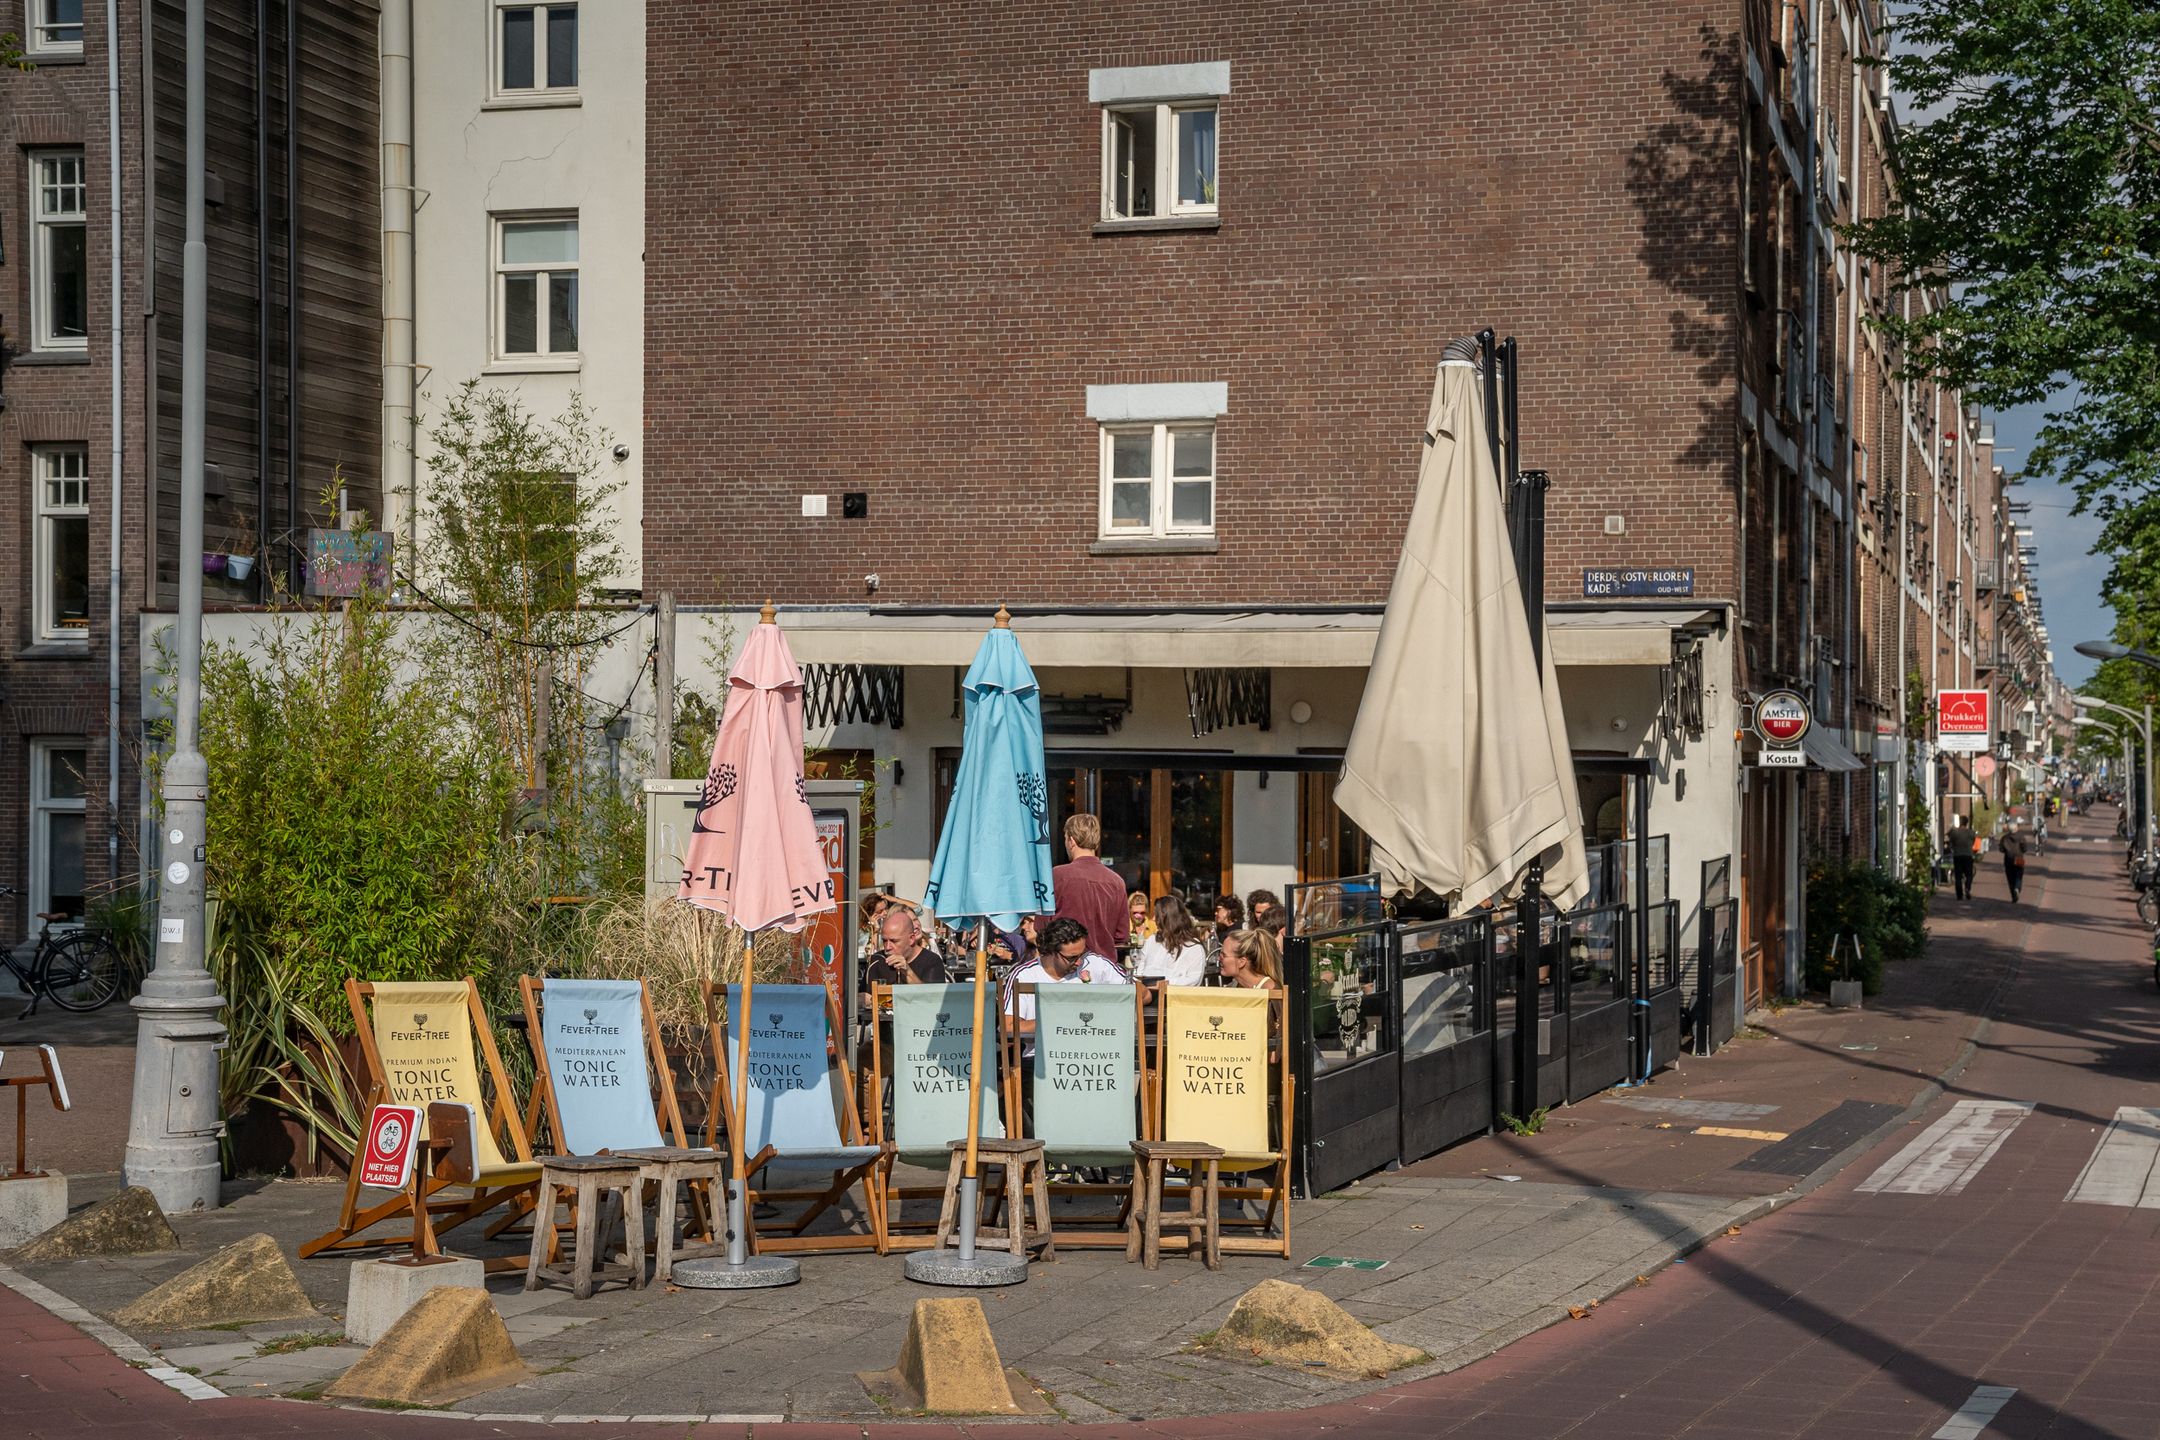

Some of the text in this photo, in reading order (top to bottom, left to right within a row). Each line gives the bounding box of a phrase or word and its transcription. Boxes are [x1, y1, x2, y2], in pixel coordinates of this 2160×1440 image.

[1587, 571, 1690, 582] DERDE KOSTVERLOREN
[1587, 583, 1611, 594] KADE
[1765, 709, 1801, 718] AMSTEL
[1942, 713, 1984, 722] Drukkerij
[1942, 722, 1984, 730] Overtoom
[1766, 754, 1798, 764] Kosta
[560, 1024, 619, 1035] FEVER-TREE
[913, 1027, 973, 1037] FEVER-TREE
[1056, 1026, 1117, 1036] FEVER-TREE
[391, 1031, 450, 1041] FEVER-TREE
[1185, 1030, 1246, 1041] FEVER-TREE
[555, 1047, 626, 1056] MEDITERRANEAN
[748, 1051, 811, 1059] EDITERRANEAN
[907, 1051, 972, 1061] ELDERFLOWE
[1049, 1050, 1121, 1060] ELDERFLOWER
[427, 1056, 458, 1065] INDIAN
[1179, 1054, 1217, 1062] PREMIUM
[564, 1060, 617, 1073] TONIC
[750, 1062, 802, 1076] TONIC
[1056, 1063, 1114, 1077] TONIC
[394, 1068, 452, 1085] TONIC
[1186, 1065, 1244, 1080] TONIC
[563, 1074, 621, 1088] WATER
[749, 1077, 806, 1090] WATER
[912, 1078, 971, 1093] WATE
[1053, 1077, 1117, 1091] WATER
[1183, 1080, 1246, 1095] WATER
[393, 1085, 458, 1101] WATER
[368, 1163, 399, 1173] NIET HIER
[366, 1173, 398, 1183] PLAATSEN
